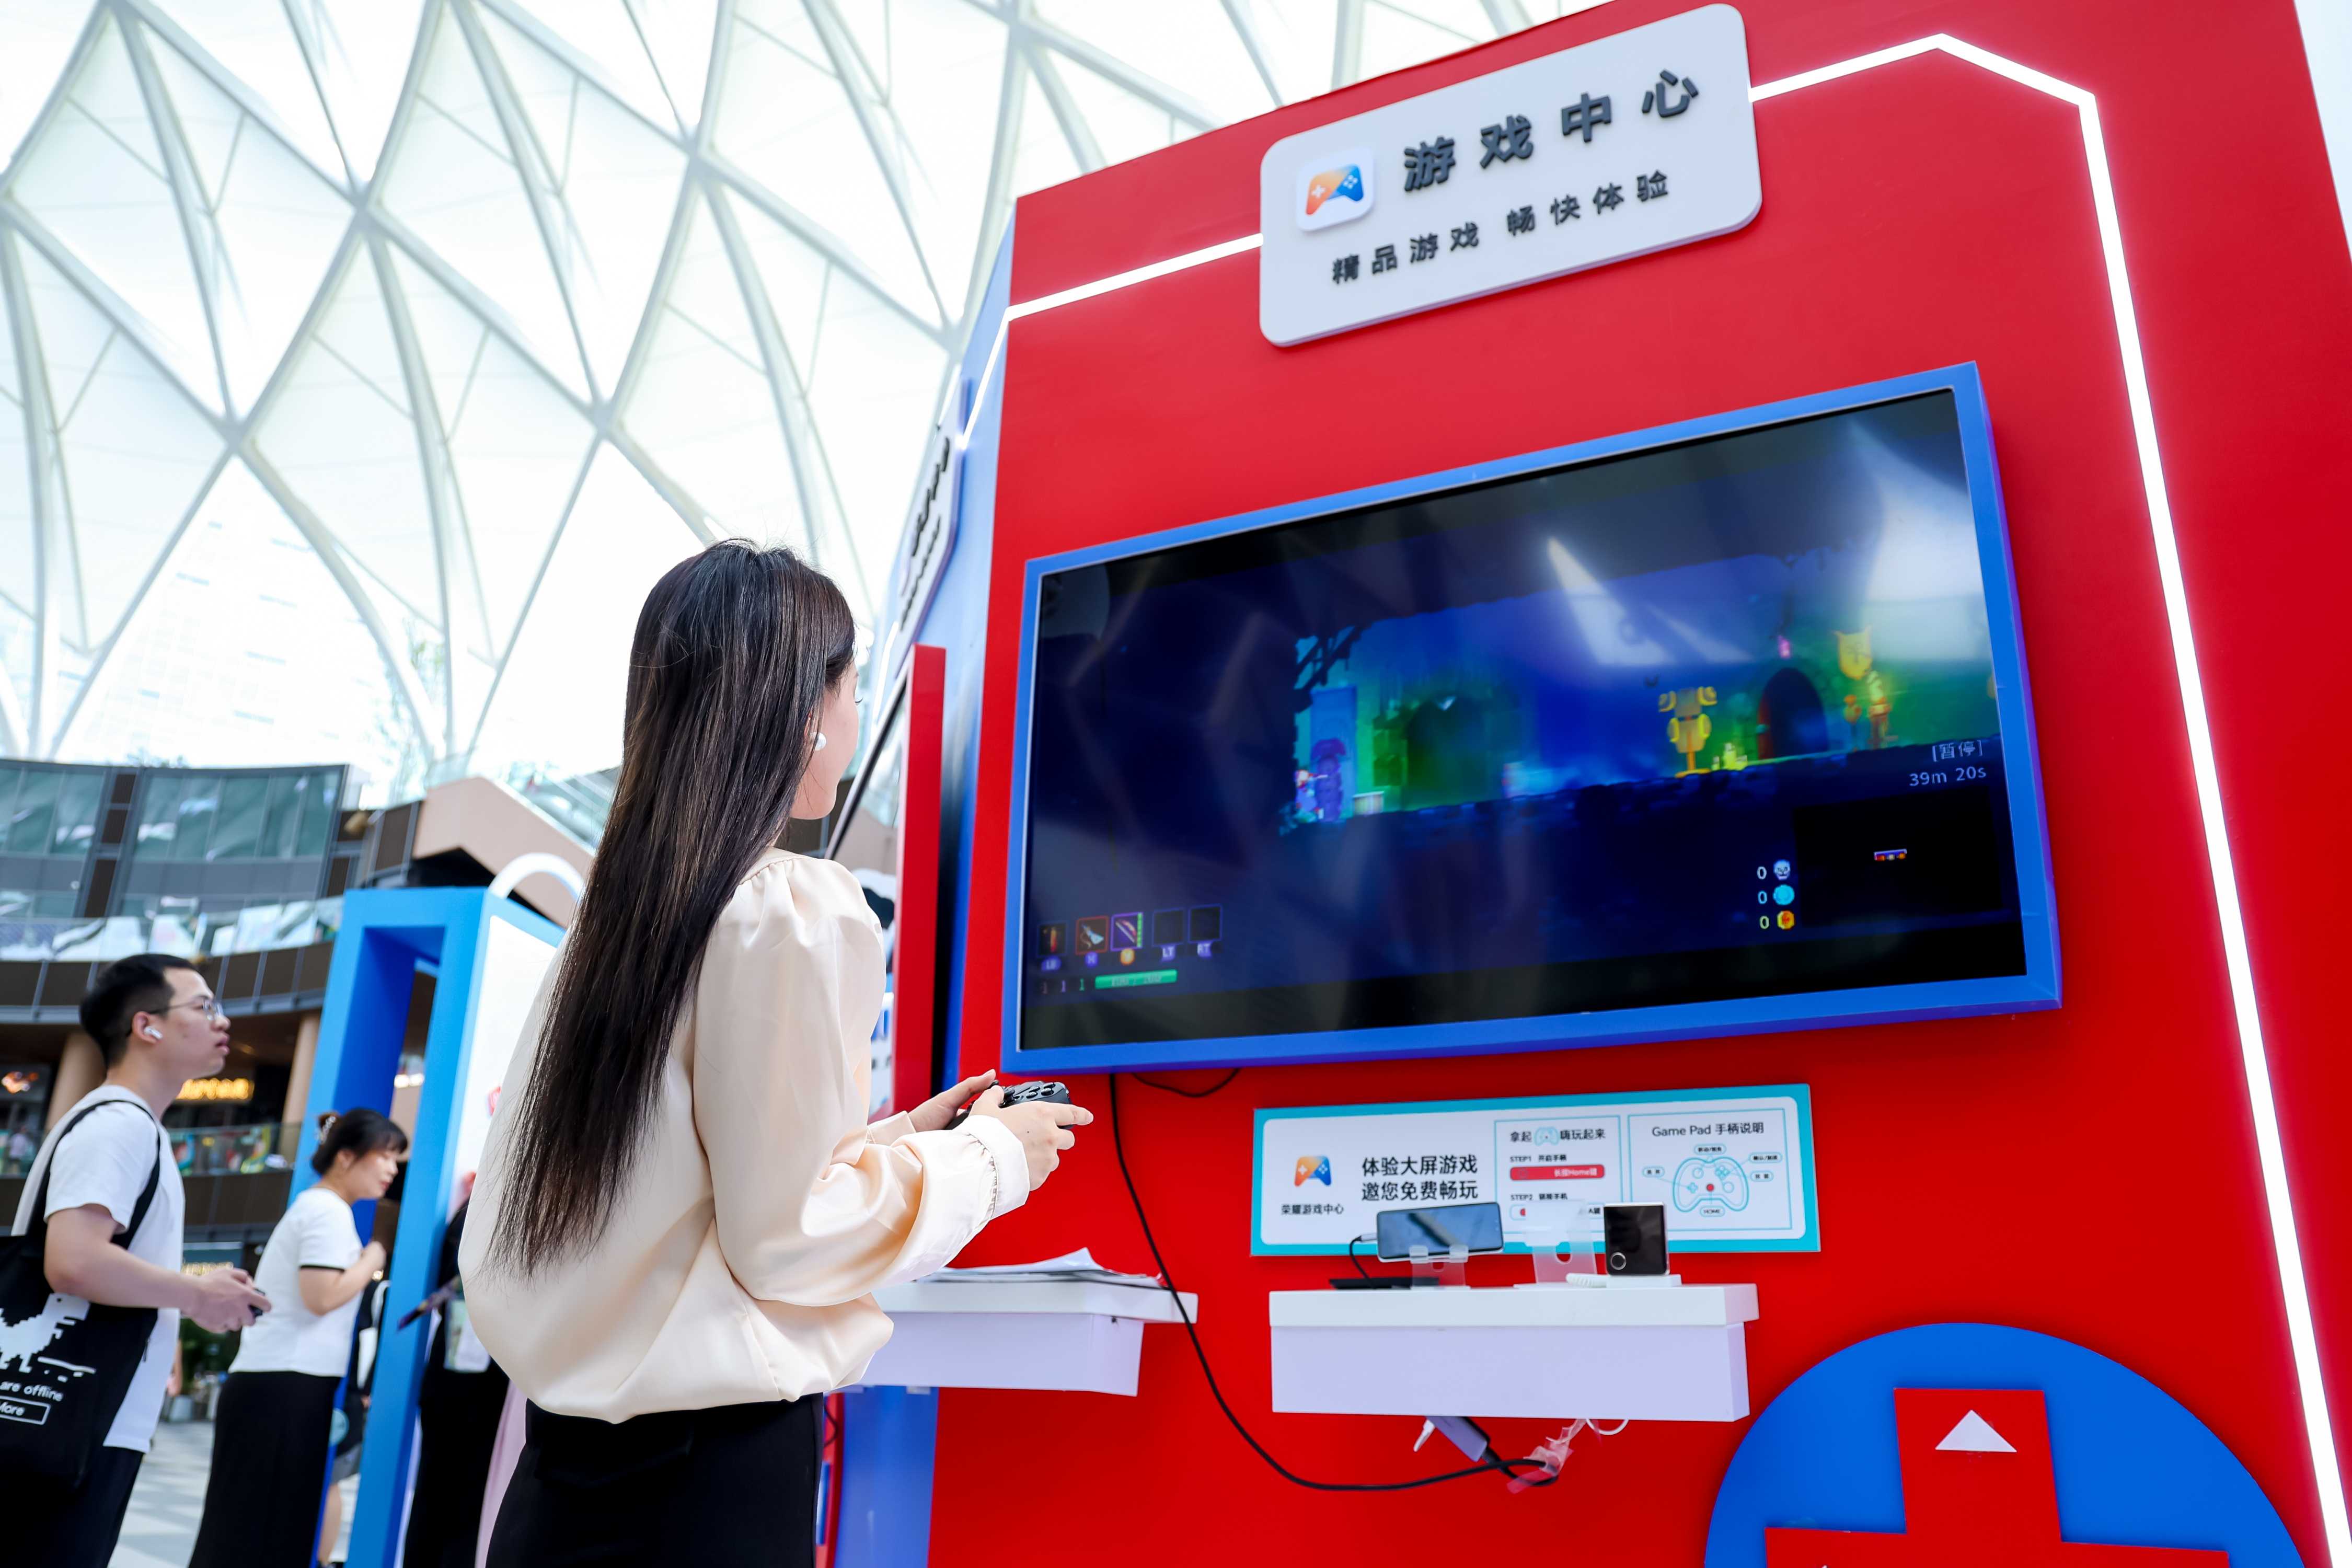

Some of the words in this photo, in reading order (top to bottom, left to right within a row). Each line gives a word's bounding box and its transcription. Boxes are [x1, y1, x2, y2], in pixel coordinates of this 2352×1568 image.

[1403, 69, 1699, 192] 游戏中心
[1331, 222, 1480, 285] 精品游戏
[1506, 170, 1669, 236] 畅快体验
[1909, 772, 1947, 786] 39m
[1955, 767, 1986, 781] 20s
[1757, 866, 1767, 880] 0
[1758, 891, 1767, 904] 0
[1759, 916, 1769, 929] 0
[1162, 946, 1174, 958] LT
[1510, 1131, 1532, 1143] 拿起
[1652, 1126, 1686, 1137] Game
[1689, 1124, 1711, 1135] Pad
[1715, 1122, 1764, 1135] 手柄说明
[1362, 1154, 1478, 1177] 体验大屏游戏
[1362, 1180, 1479, 1201] 邀您免费畅玩
[1281, 1204, 1344, 1216] 荣耀游戏中心
[0, 1381, 21, 1392] are
[24, 1384, 63, 1402] offline
